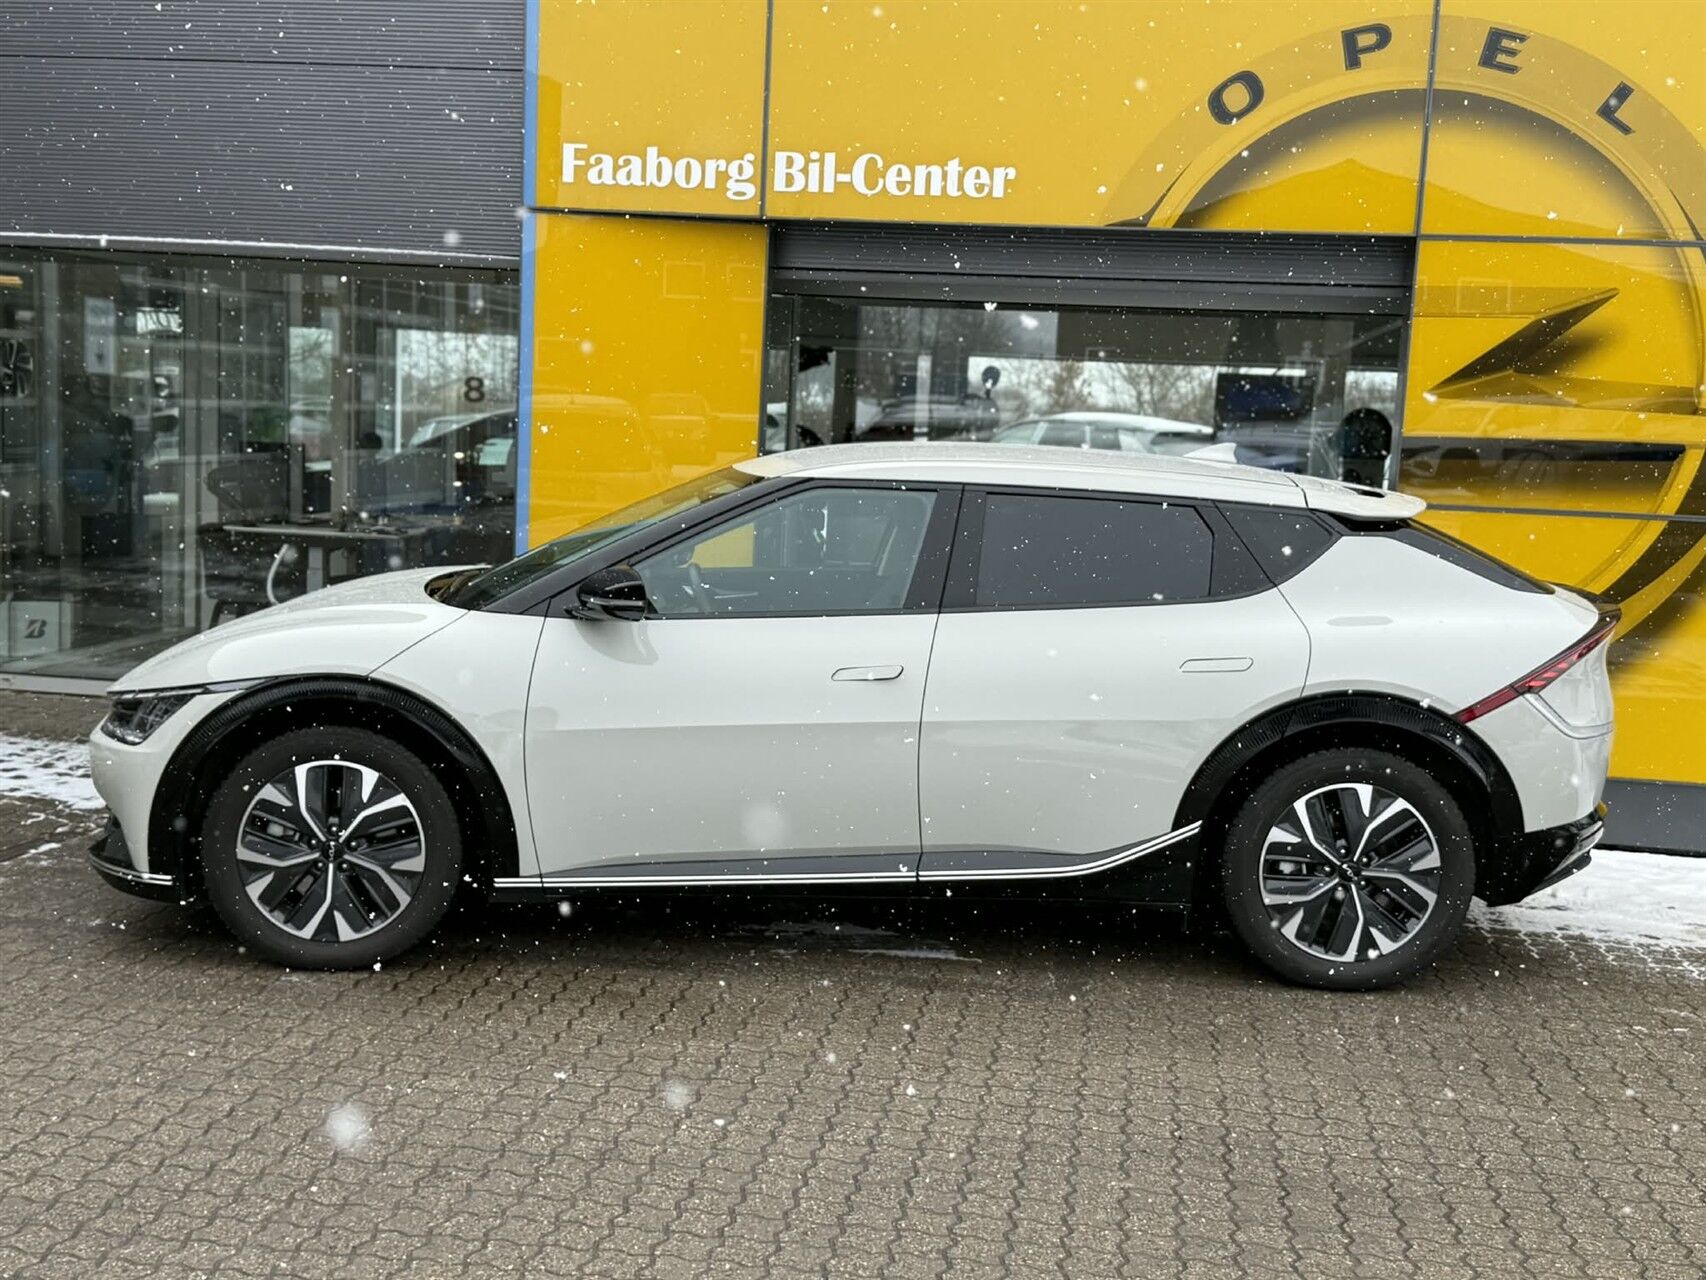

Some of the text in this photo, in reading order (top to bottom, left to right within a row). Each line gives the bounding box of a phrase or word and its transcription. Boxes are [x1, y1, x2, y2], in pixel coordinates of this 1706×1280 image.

[1208, 23, 1635, 135] OPEL
[561, 143, 1015, 201] Faaborg Bil-Center
[464, 376, 485, 402] 8
